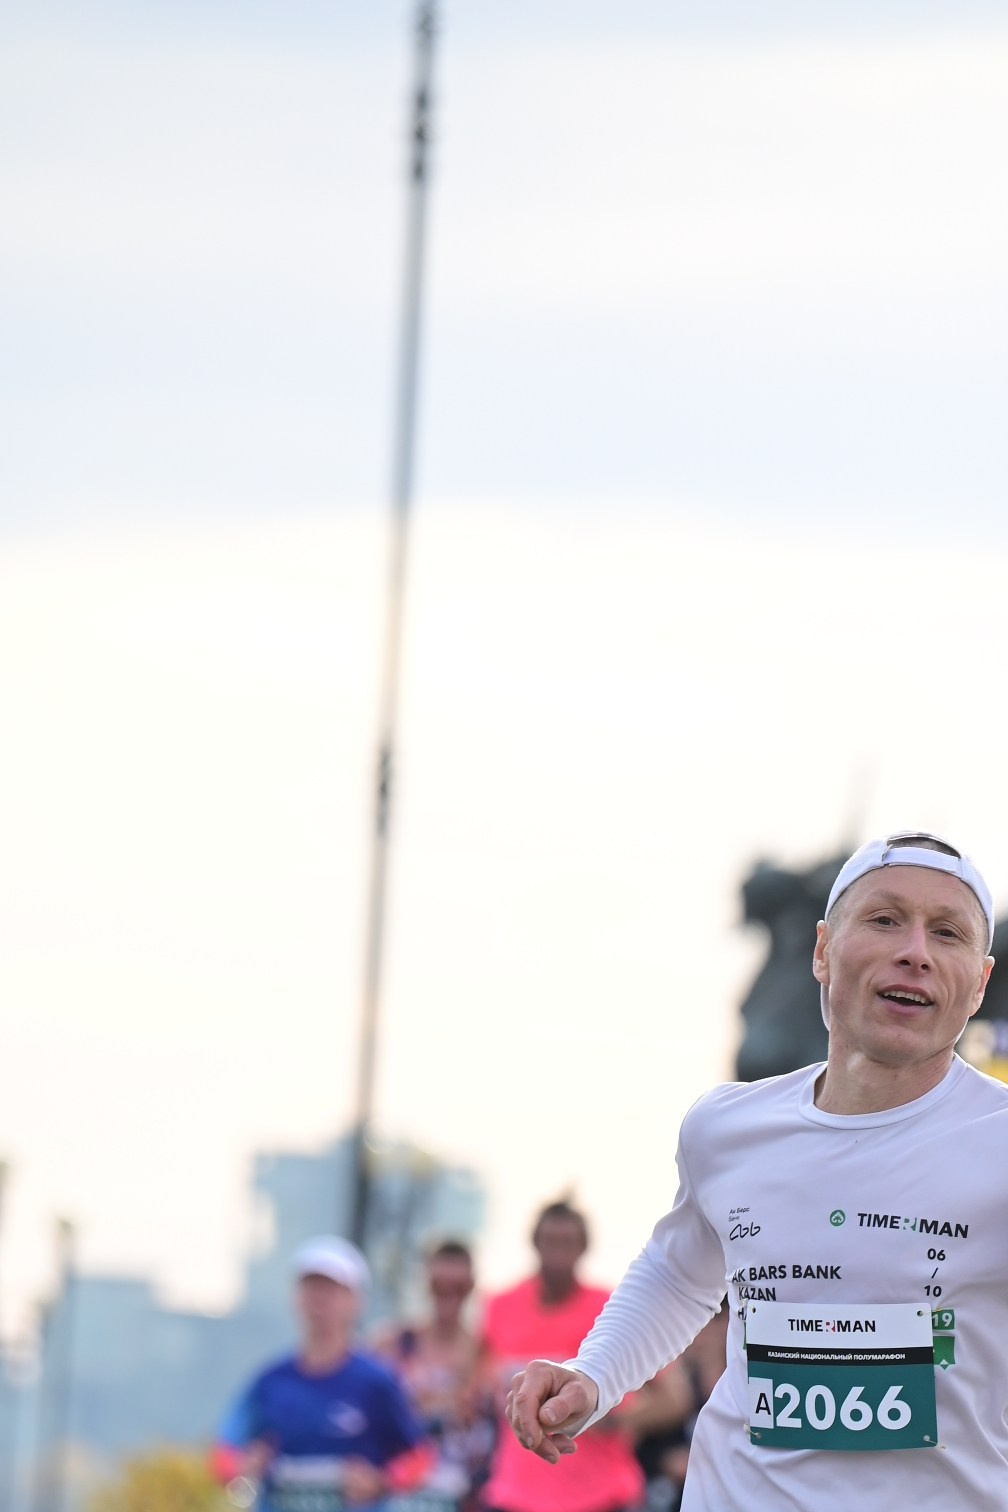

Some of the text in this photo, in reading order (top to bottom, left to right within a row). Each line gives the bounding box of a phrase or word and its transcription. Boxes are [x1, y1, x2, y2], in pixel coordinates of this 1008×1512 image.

[927, 1248, 946, 1261] 06
[731, 1265, 842, 1283] AK BARS BANK
[738, 1286, 777, 1301] KAZAN
[924, 1285, 942, 1297] 10
[767, 1351, 906, 1361] КАЗАНСКИЙ НАЦИОНАЛЬНЫЙ ПОЛУМАРАФОН
[774, 1383, 912, 1431] 2066
